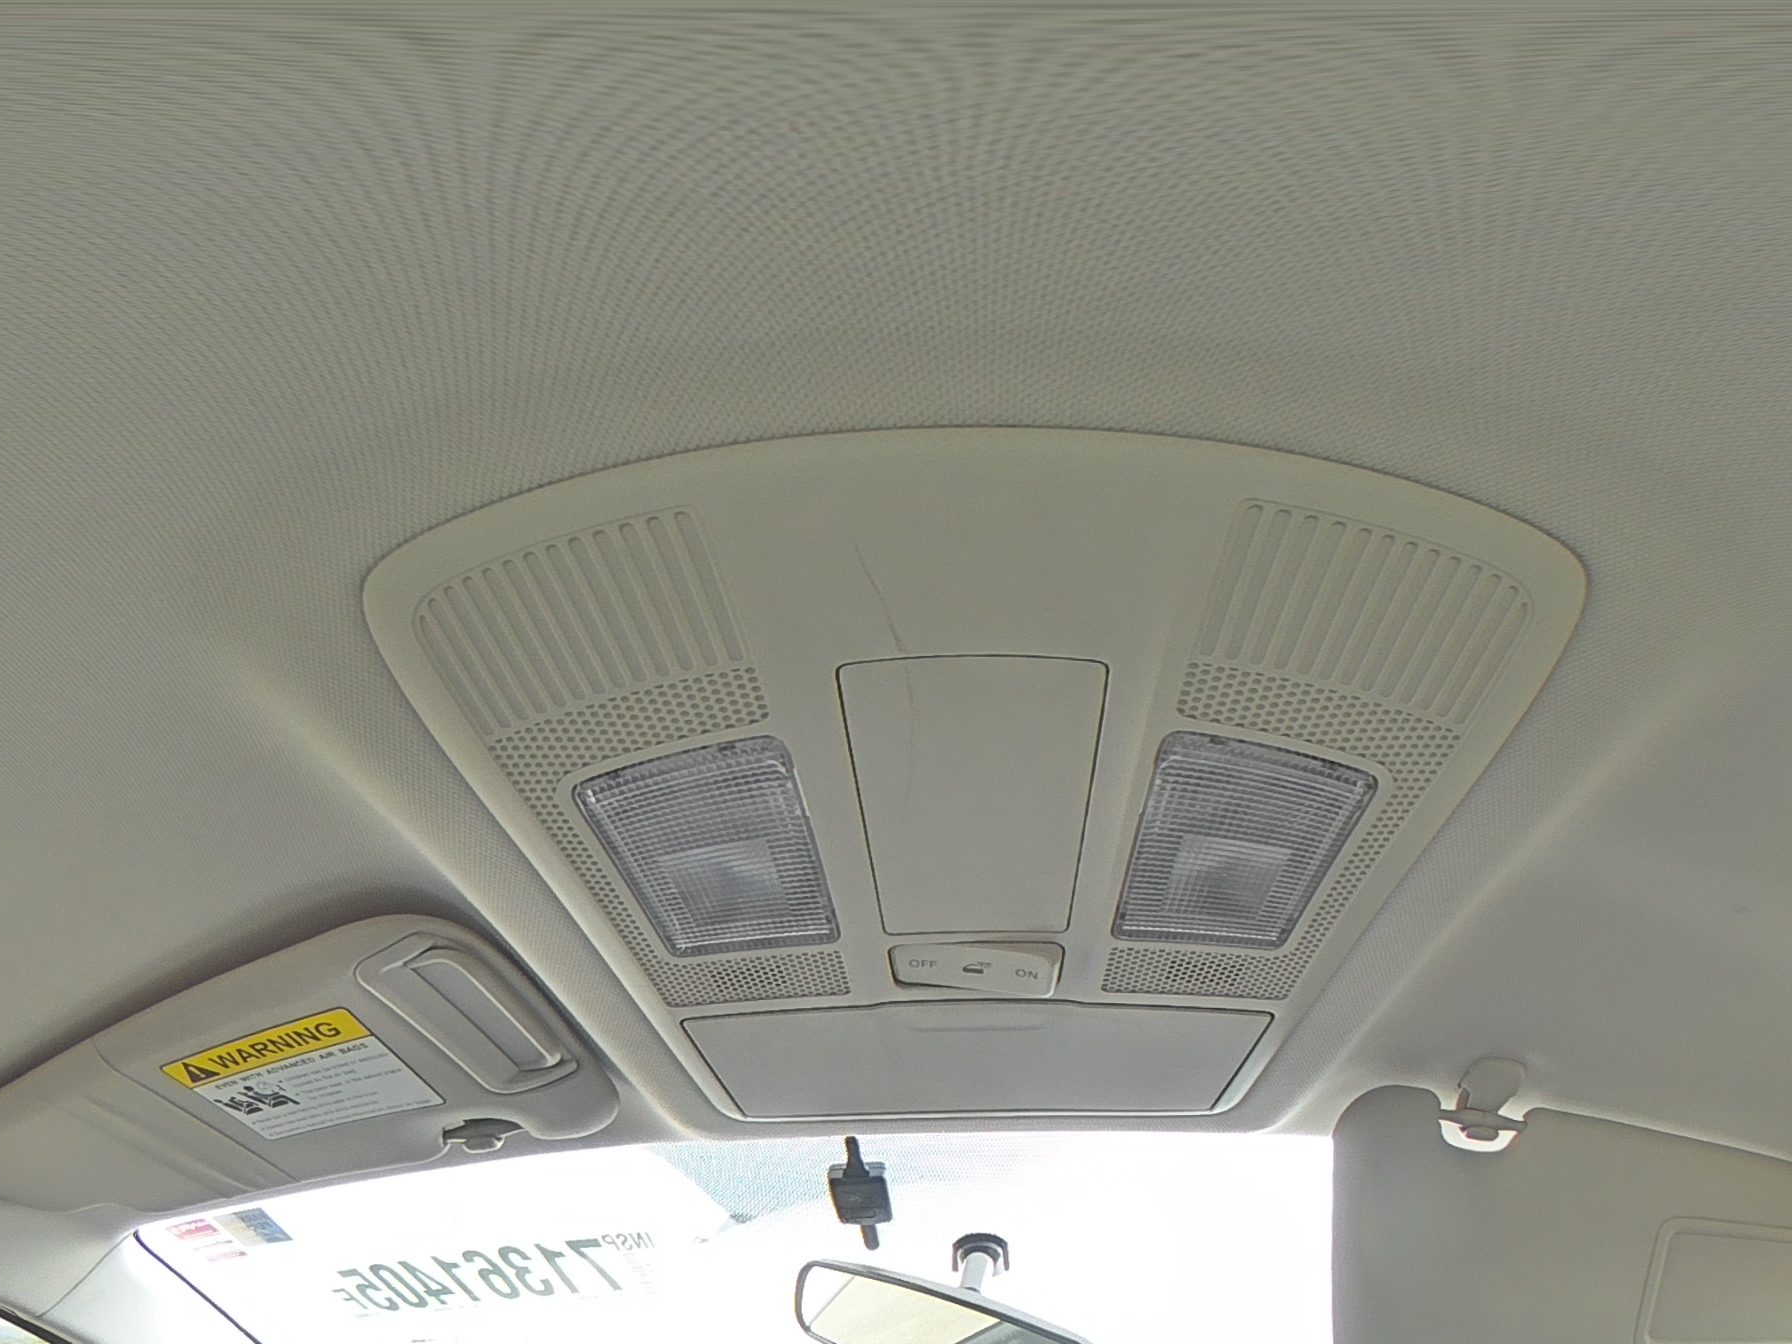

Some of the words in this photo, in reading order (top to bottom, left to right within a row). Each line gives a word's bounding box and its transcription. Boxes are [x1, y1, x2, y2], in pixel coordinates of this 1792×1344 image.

[909, 959, 938, 969] OFF
[1015, 969, 1039, 980] ON
[208, 1021, 343, 1070] WARNING
[214, 1080, 238, 1090] EVEN
[239, 1072, 264, 1082] WITH
[266, 1056, 316, 1076] ADVANCED
[318, 1050, 337, 1061] AIR
[338, 1042, 370, 1055] BAGS
